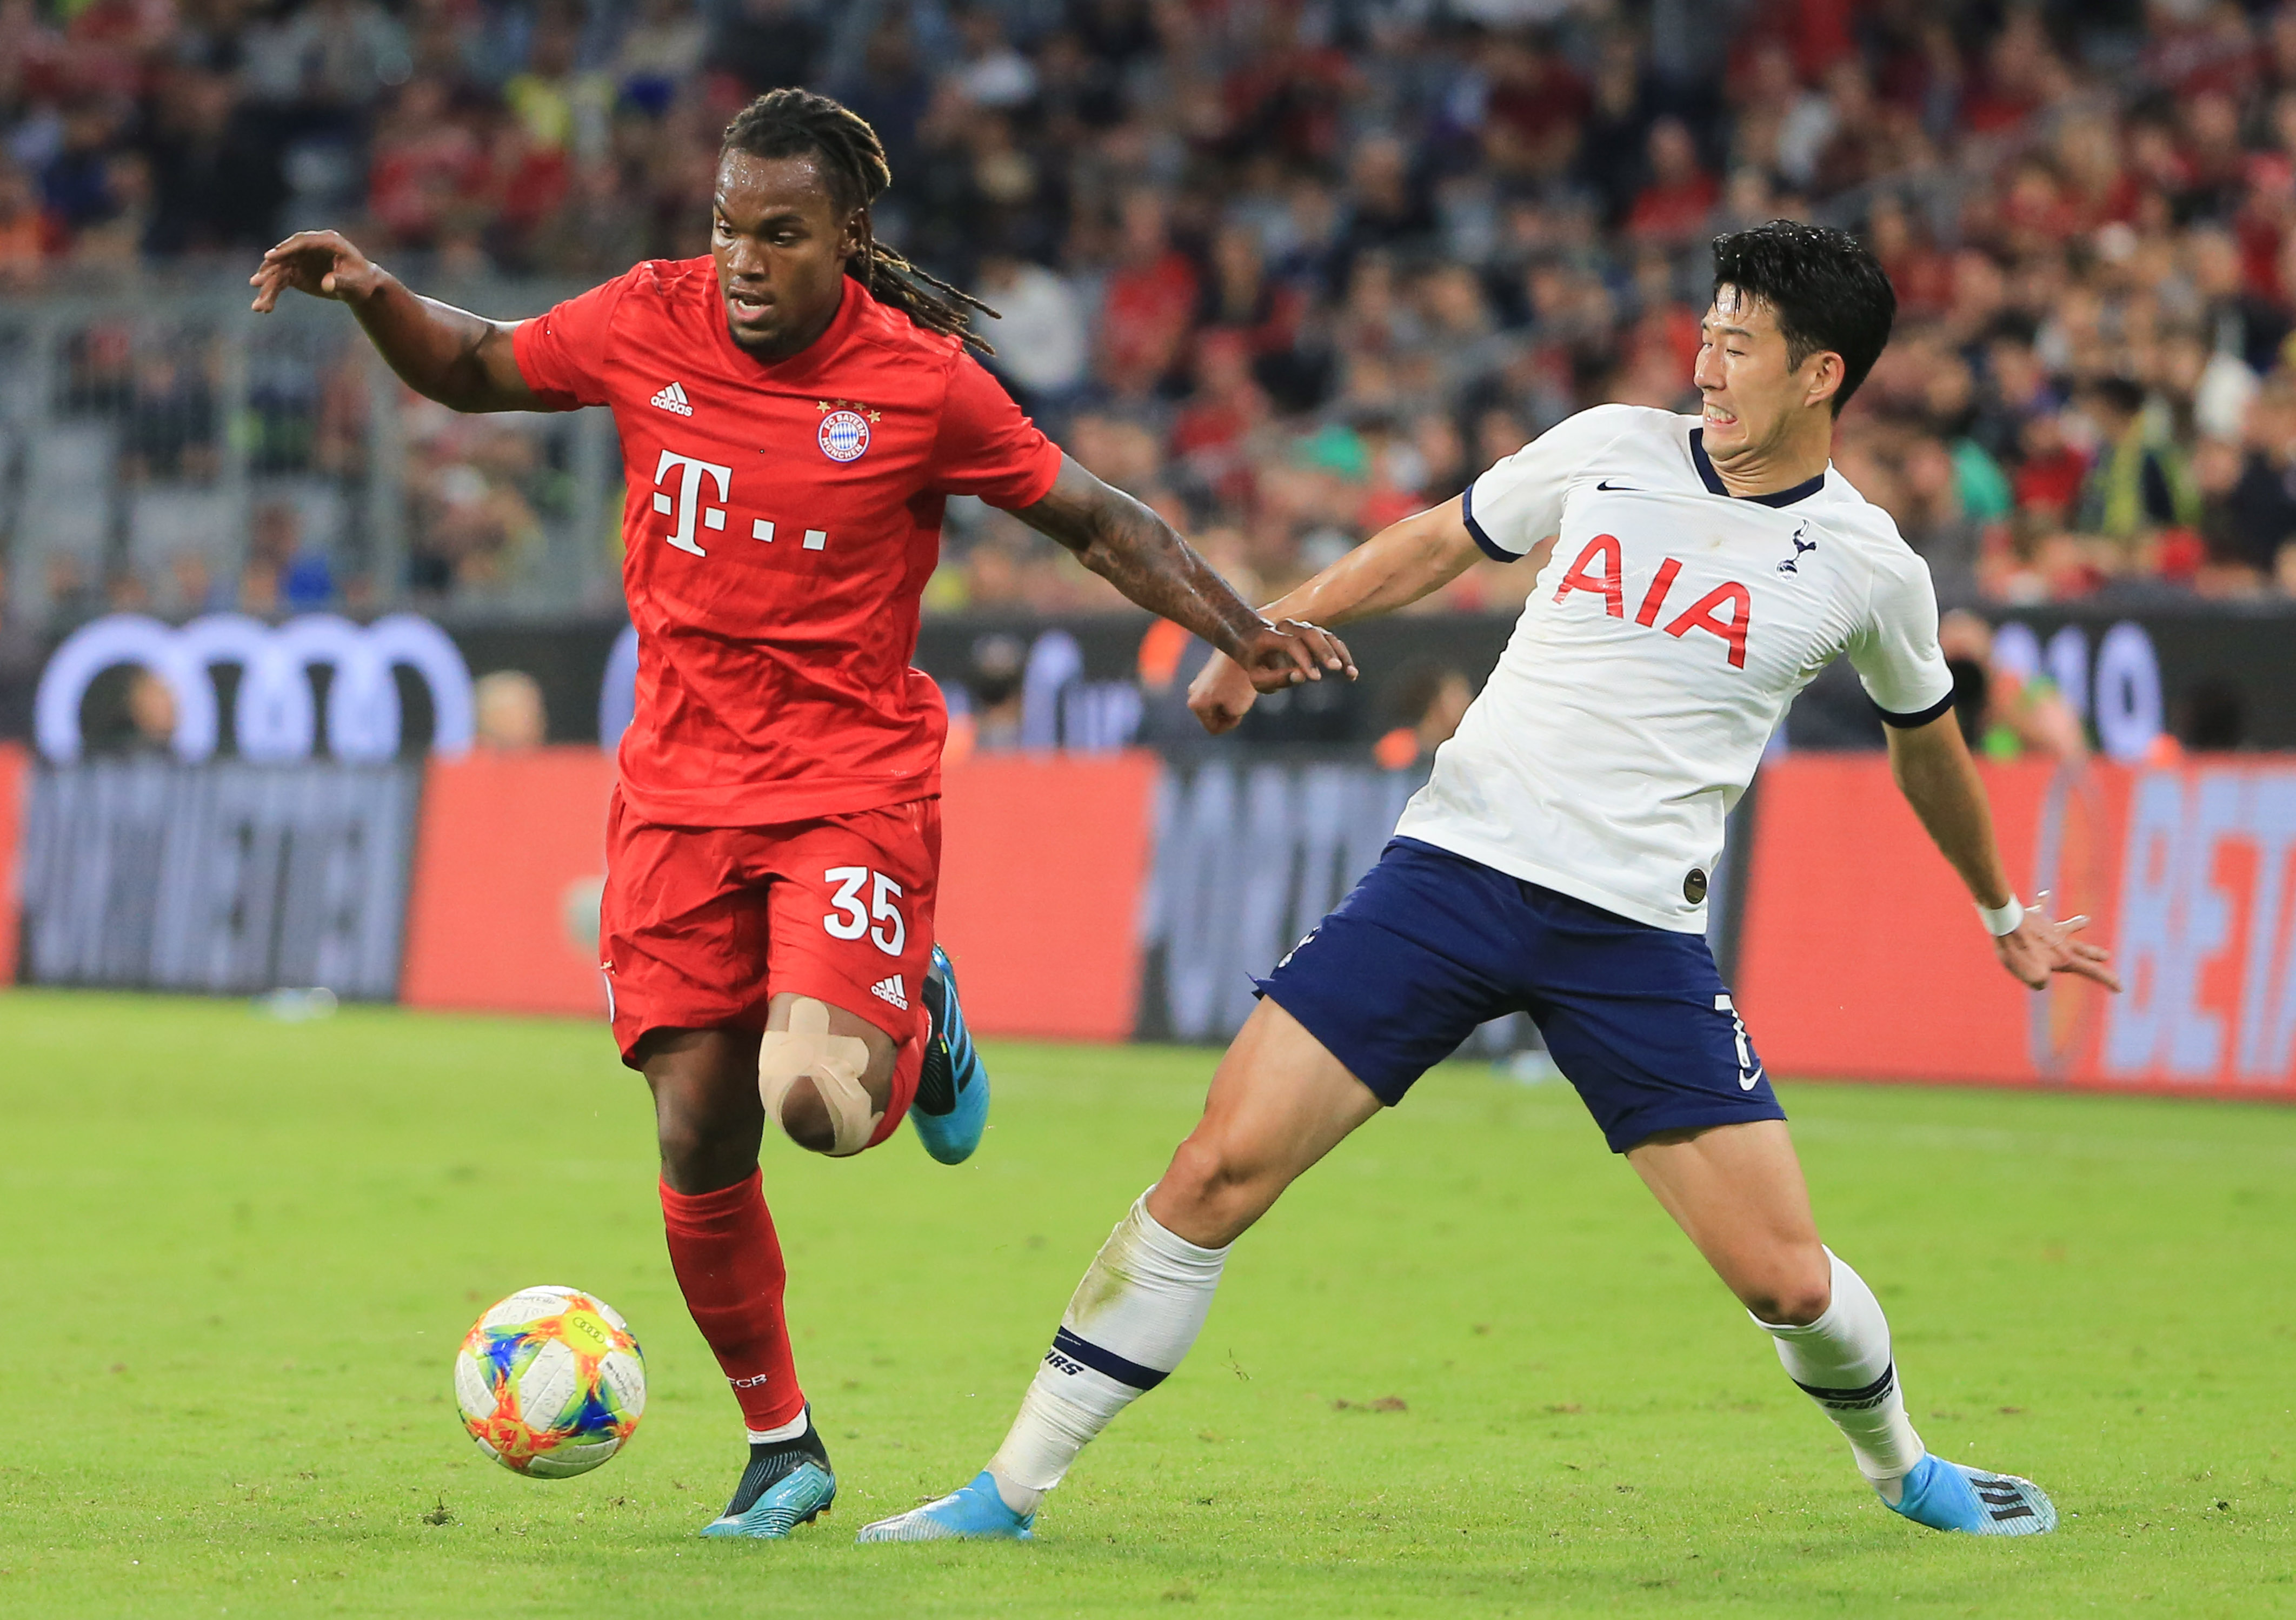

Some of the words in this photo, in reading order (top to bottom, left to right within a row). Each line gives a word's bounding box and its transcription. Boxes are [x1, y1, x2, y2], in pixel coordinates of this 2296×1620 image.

[650, 396, 693, 417] adidas
[824, 418, 836, 430] FC
[836, 414, 866, 437] BAYERN
[1552, 533, 1751, 670] AIA
[823, 866, 906, 957] 35
[871, 985, 908, 1010] adidas
